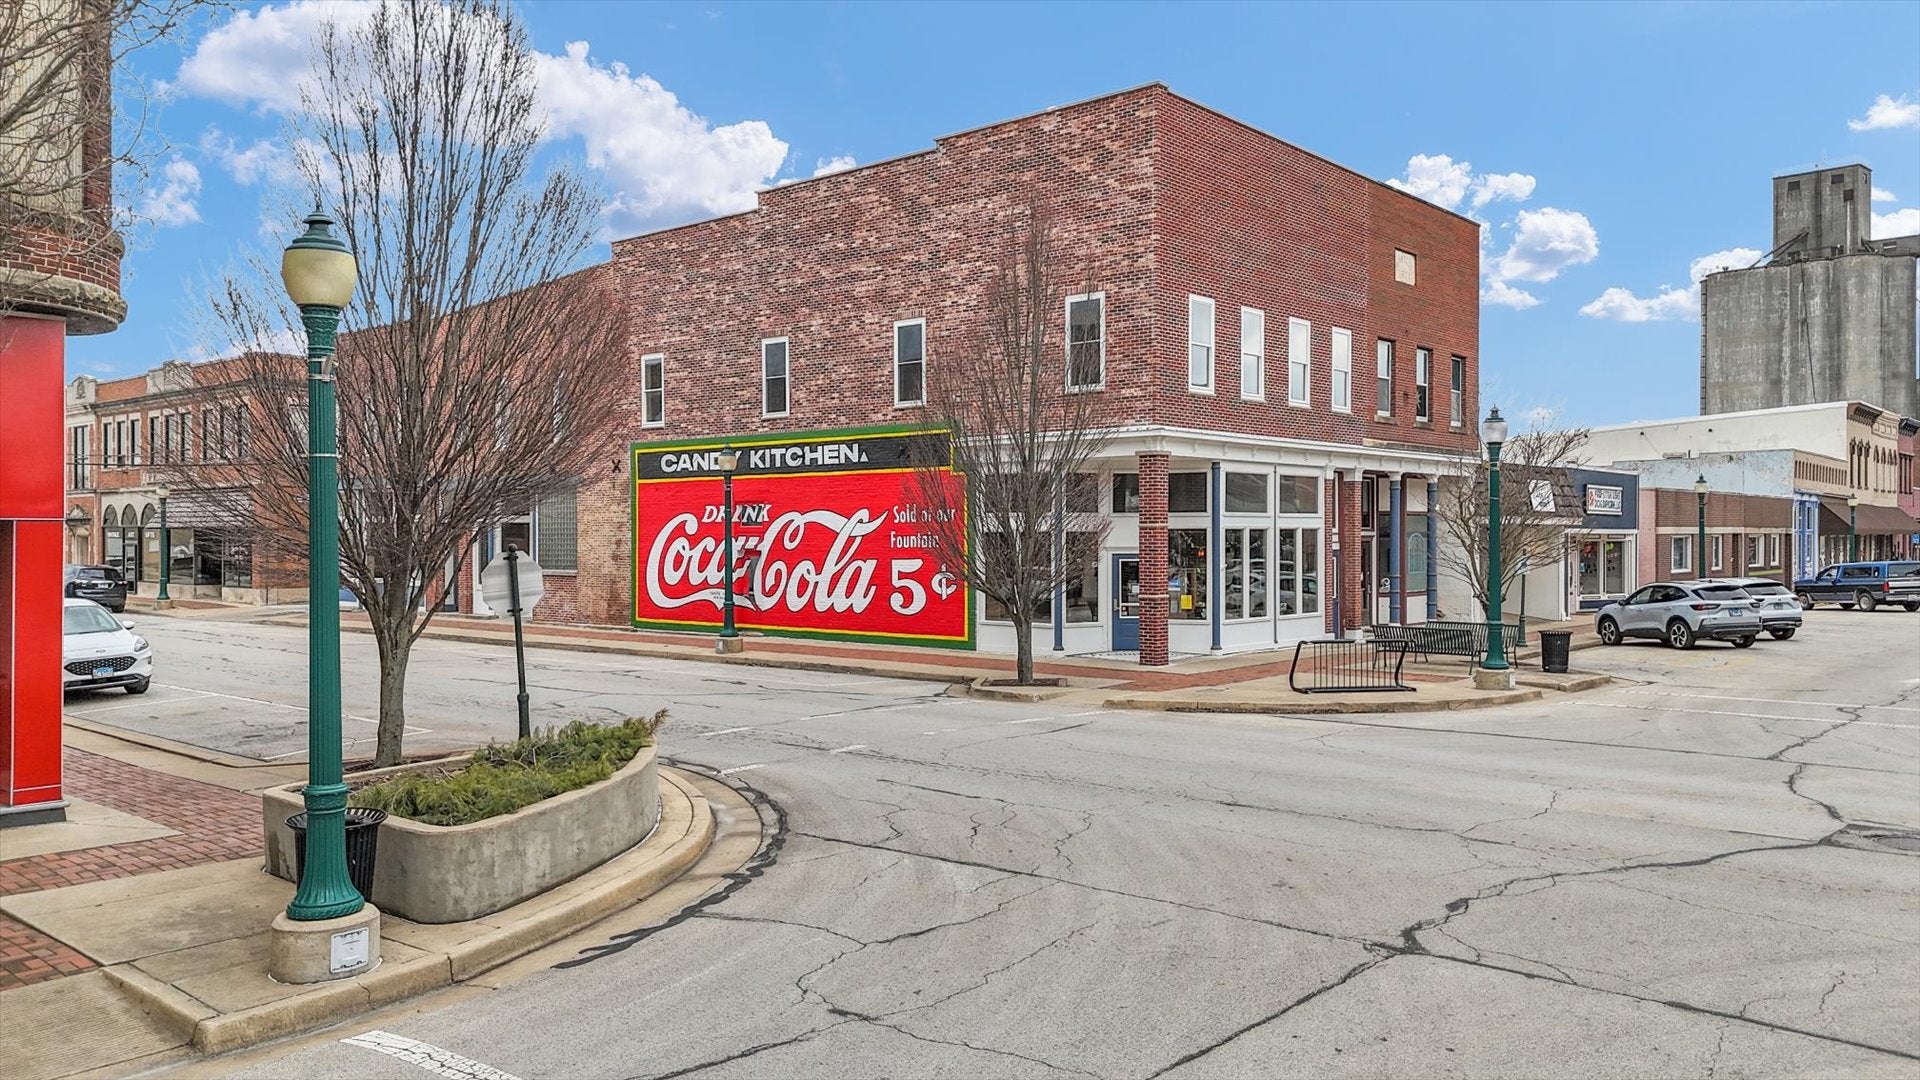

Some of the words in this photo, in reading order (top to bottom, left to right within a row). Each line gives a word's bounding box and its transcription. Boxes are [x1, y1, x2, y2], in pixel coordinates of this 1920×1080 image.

[750, 443, 859, 469] KITCHEN
[893, 504, 917, 523] Sold
[646, 507, 889, 614] Coca-Cola
